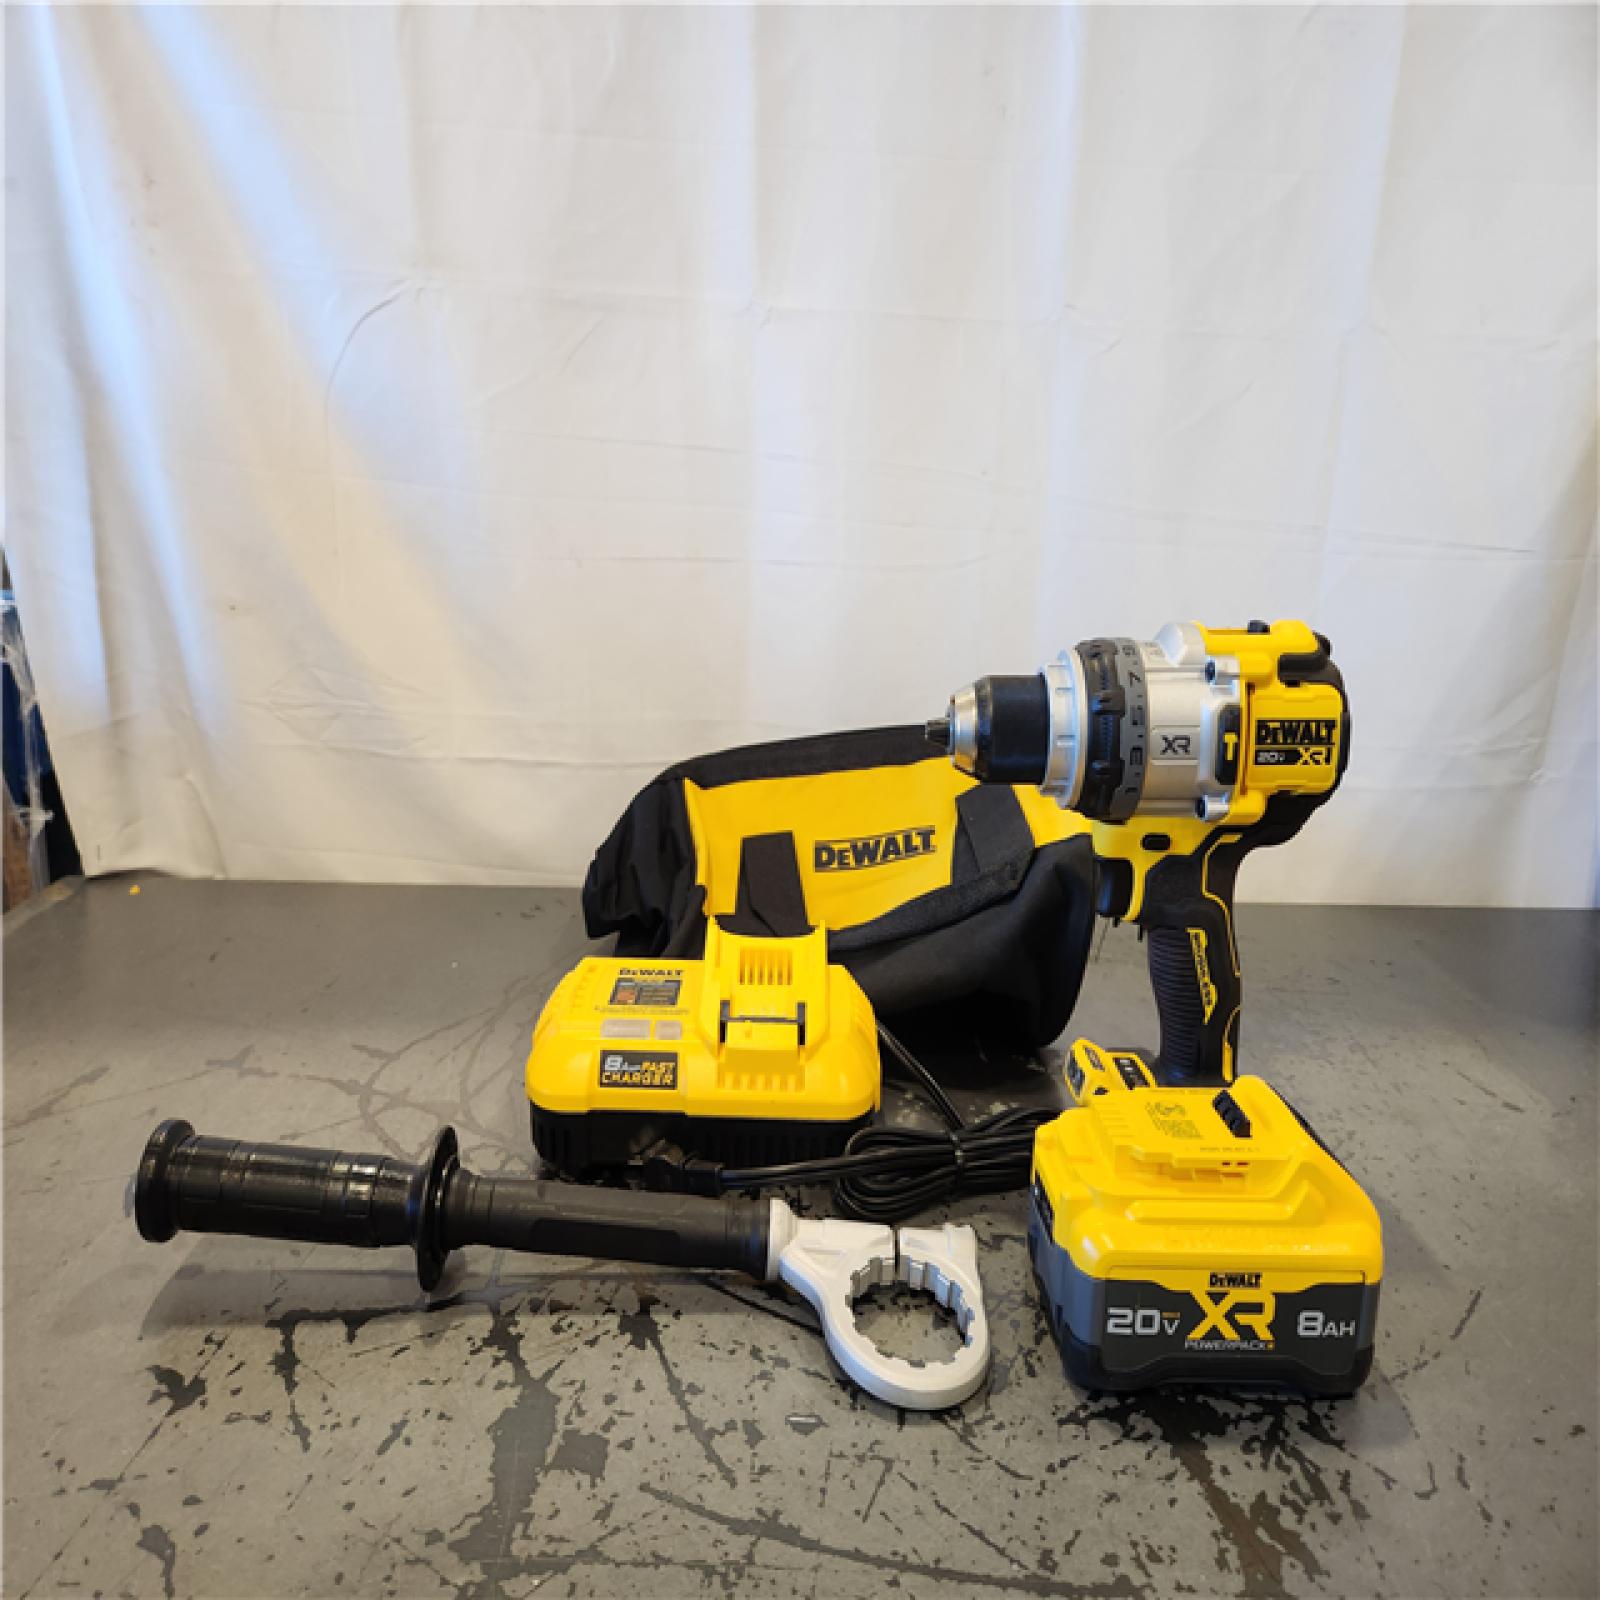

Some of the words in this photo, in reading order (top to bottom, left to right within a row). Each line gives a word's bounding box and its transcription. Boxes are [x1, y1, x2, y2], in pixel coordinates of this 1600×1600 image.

[1160, 734, 1191, 755] XR
[814, 825, 936, 872] DEWALT
[601, 1071, 674, 1086] CHARGER
[1186, 1290, 1276, 1341] XR
